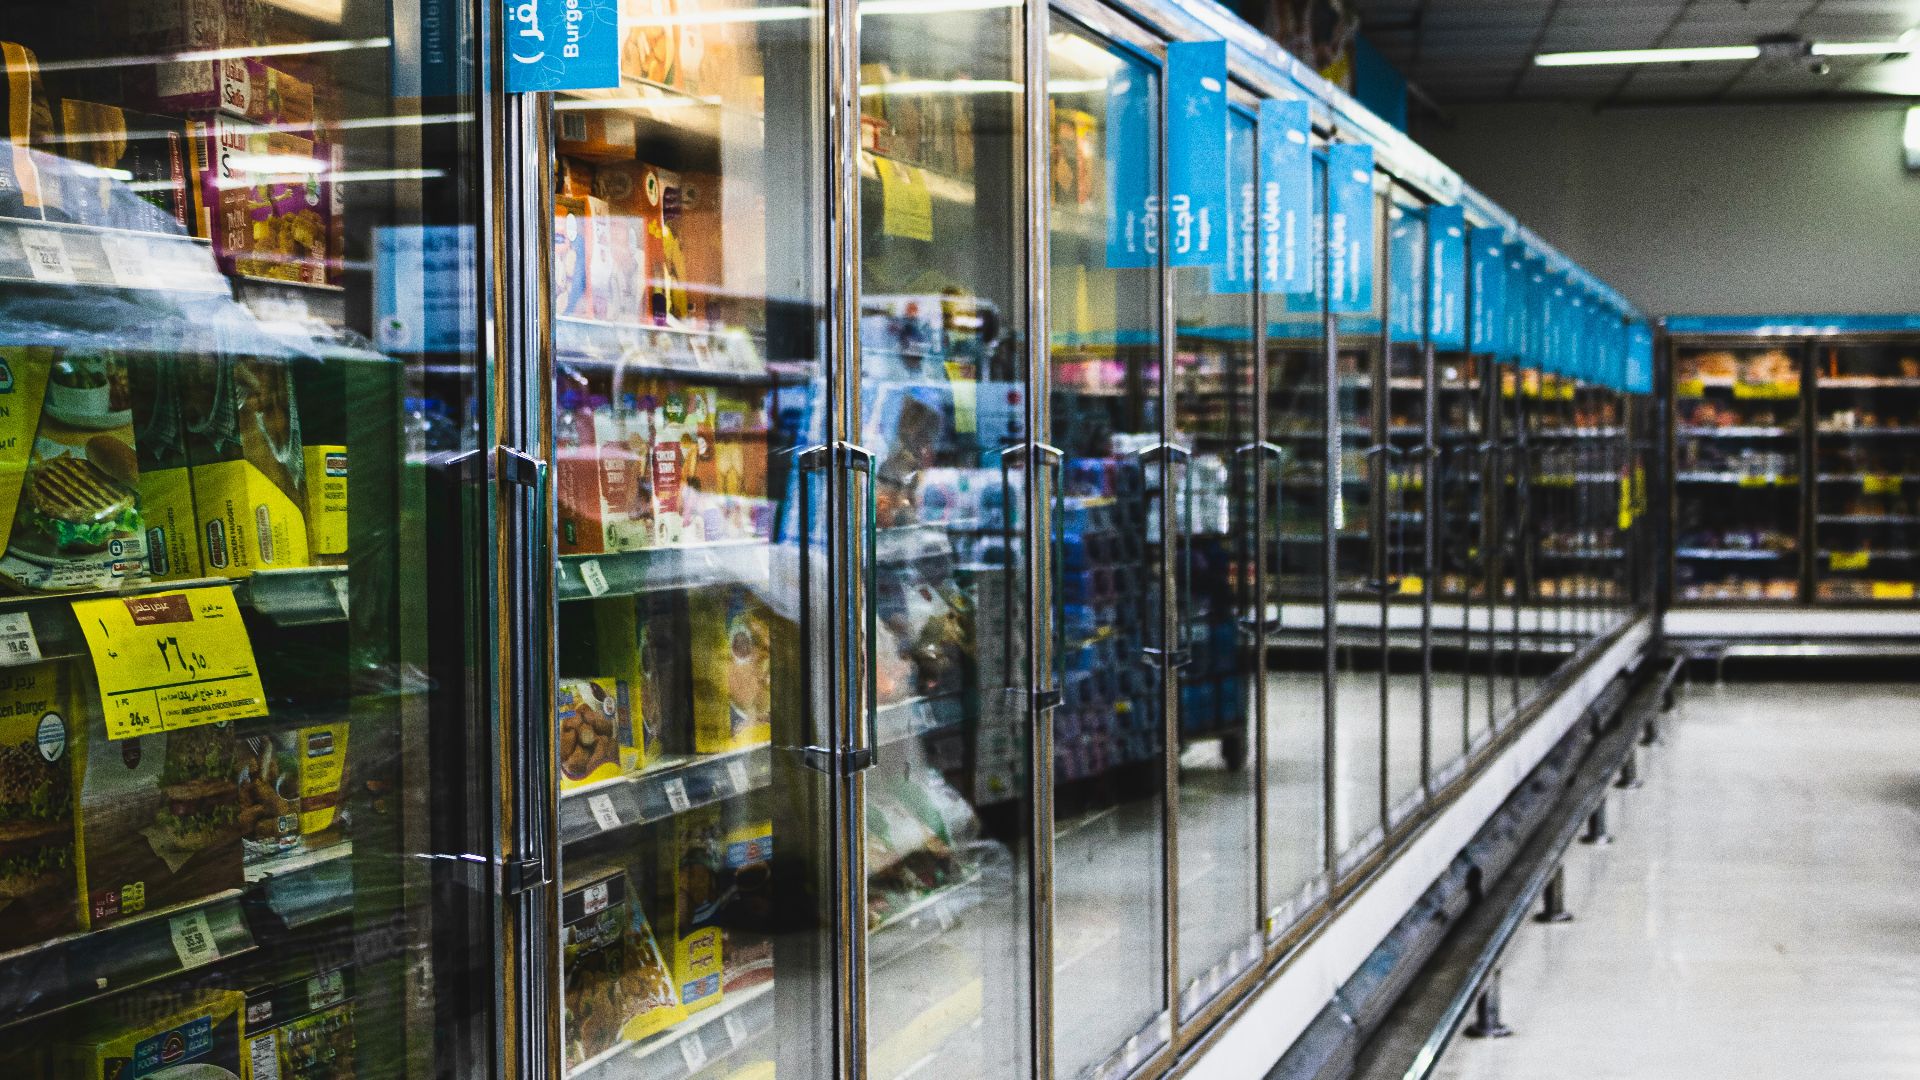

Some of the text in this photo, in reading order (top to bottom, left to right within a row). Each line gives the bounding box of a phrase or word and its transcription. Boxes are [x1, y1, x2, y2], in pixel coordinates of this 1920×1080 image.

[225, 499, 240, 568] CHICKEN NUGGETS
[15, 700, 47, 716] Burger
